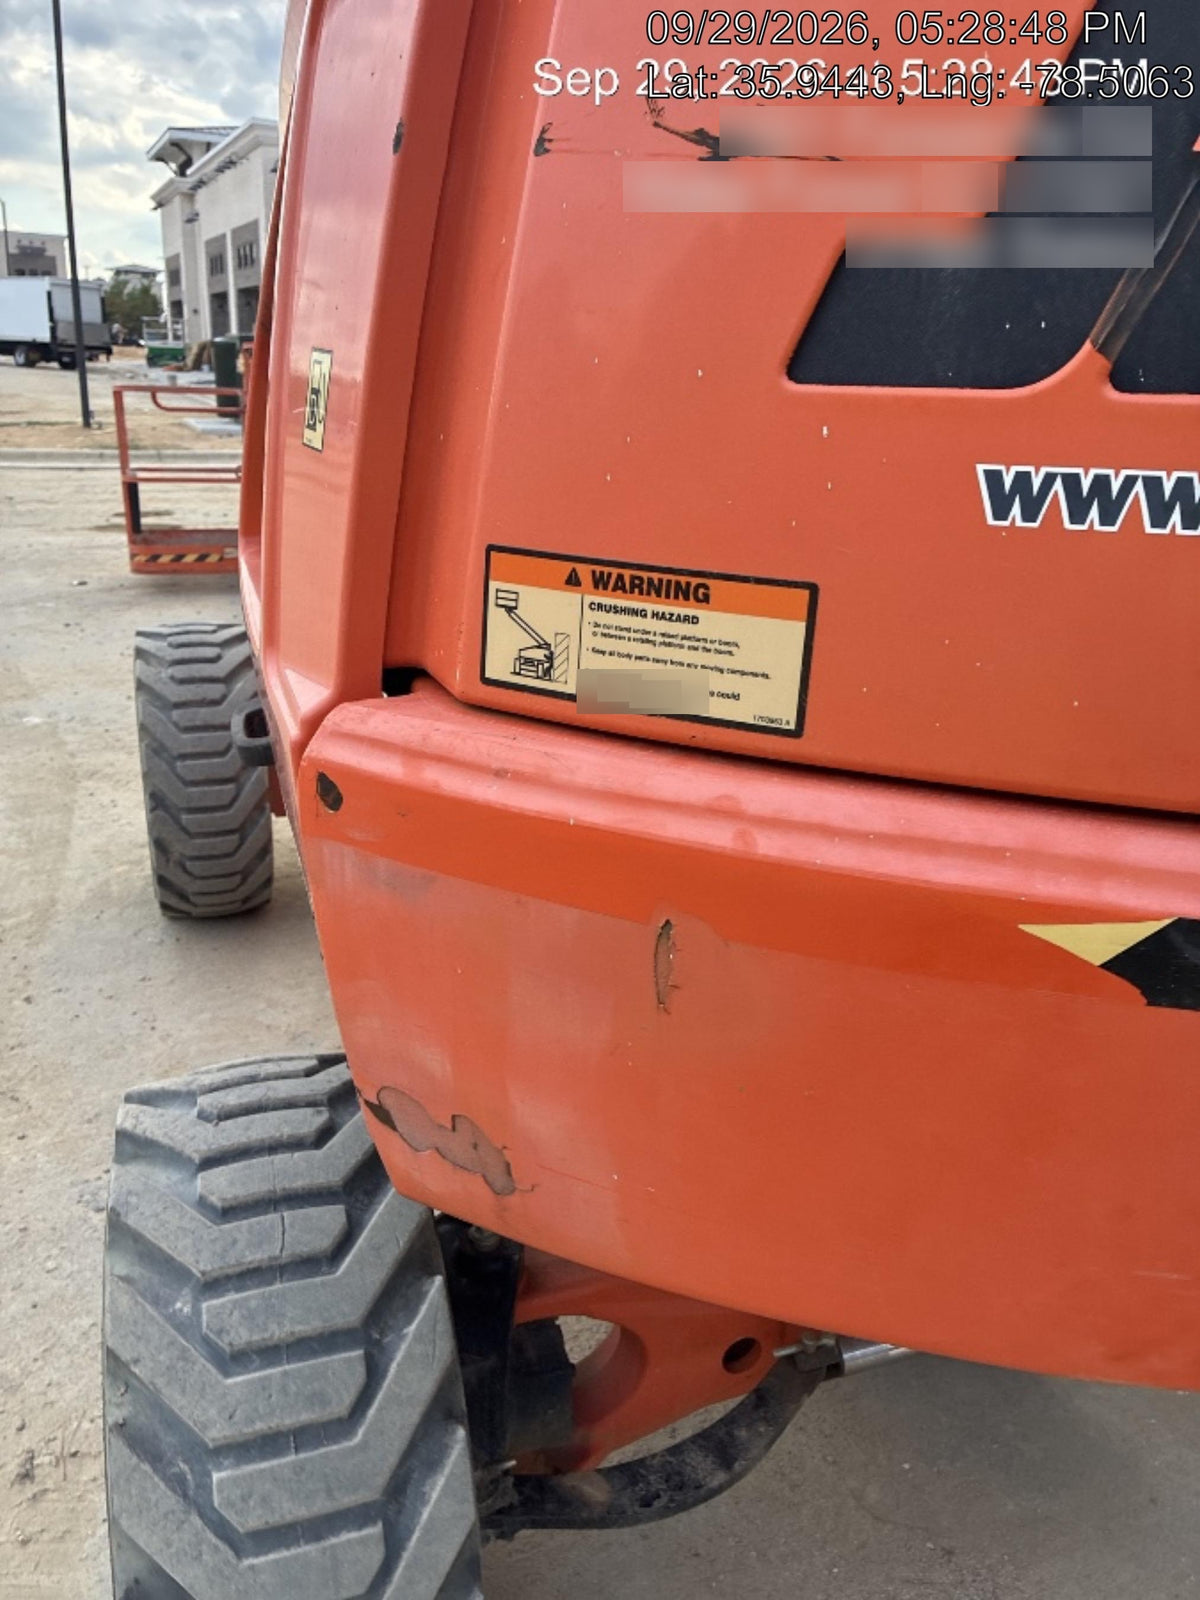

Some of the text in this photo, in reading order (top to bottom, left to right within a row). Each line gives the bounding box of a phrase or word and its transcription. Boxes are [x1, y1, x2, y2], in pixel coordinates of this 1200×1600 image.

[591, 569, 711, 604] WARNING
[588, 601, 700, 625] CRUSHING HAZARD
